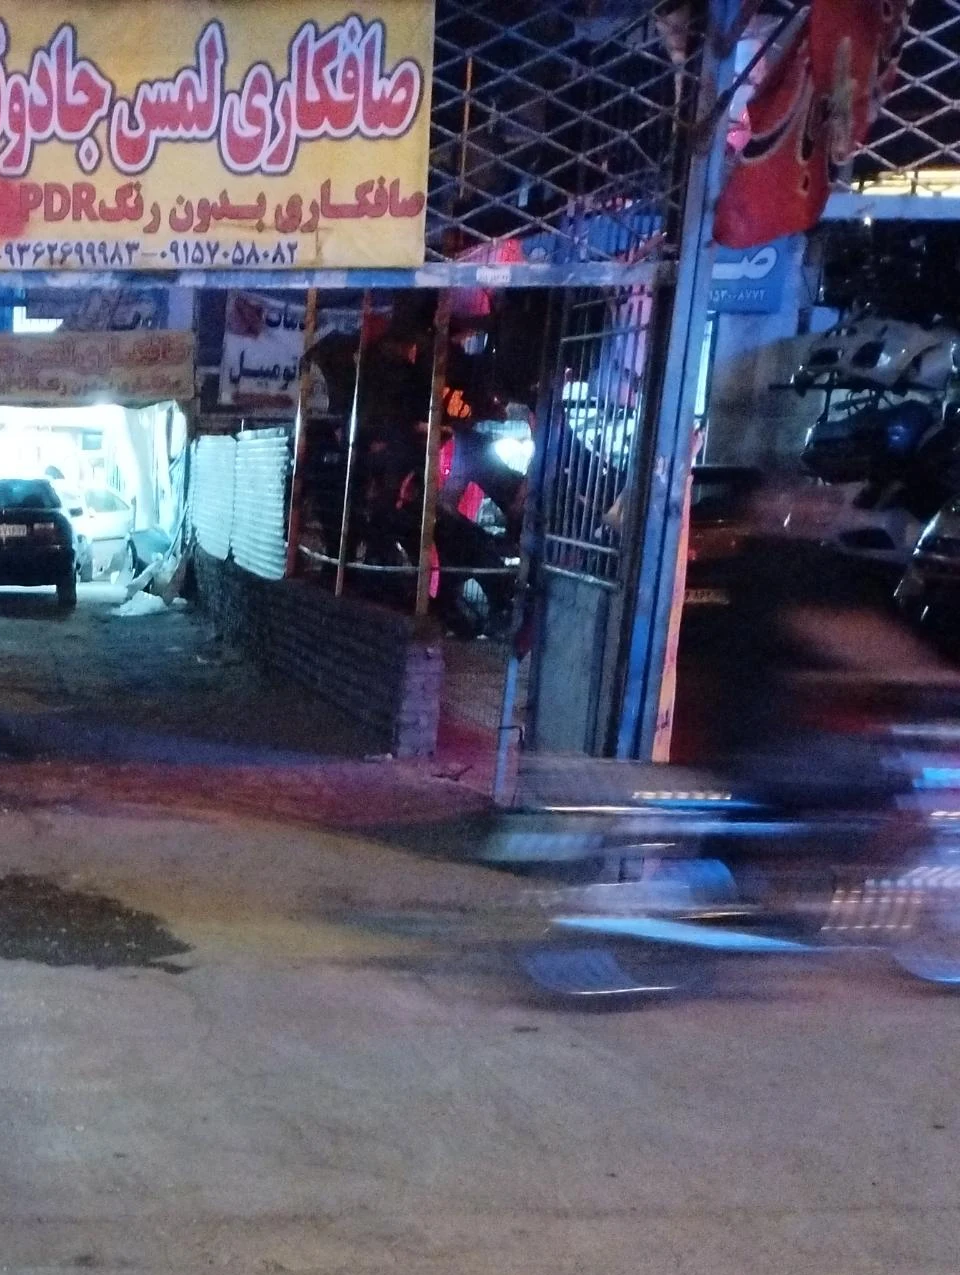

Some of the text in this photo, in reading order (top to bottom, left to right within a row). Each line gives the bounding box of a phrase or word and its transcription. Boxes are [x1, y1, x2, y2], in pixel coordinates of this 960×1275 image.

[111, 19, 225, 175] لمس
[220, 14, 422, 175] صافکاری
[19, 182, 98, 222] PDR
[169, 189, 267, 233] بدون
[275, 176, 426, 233] صافکاری
